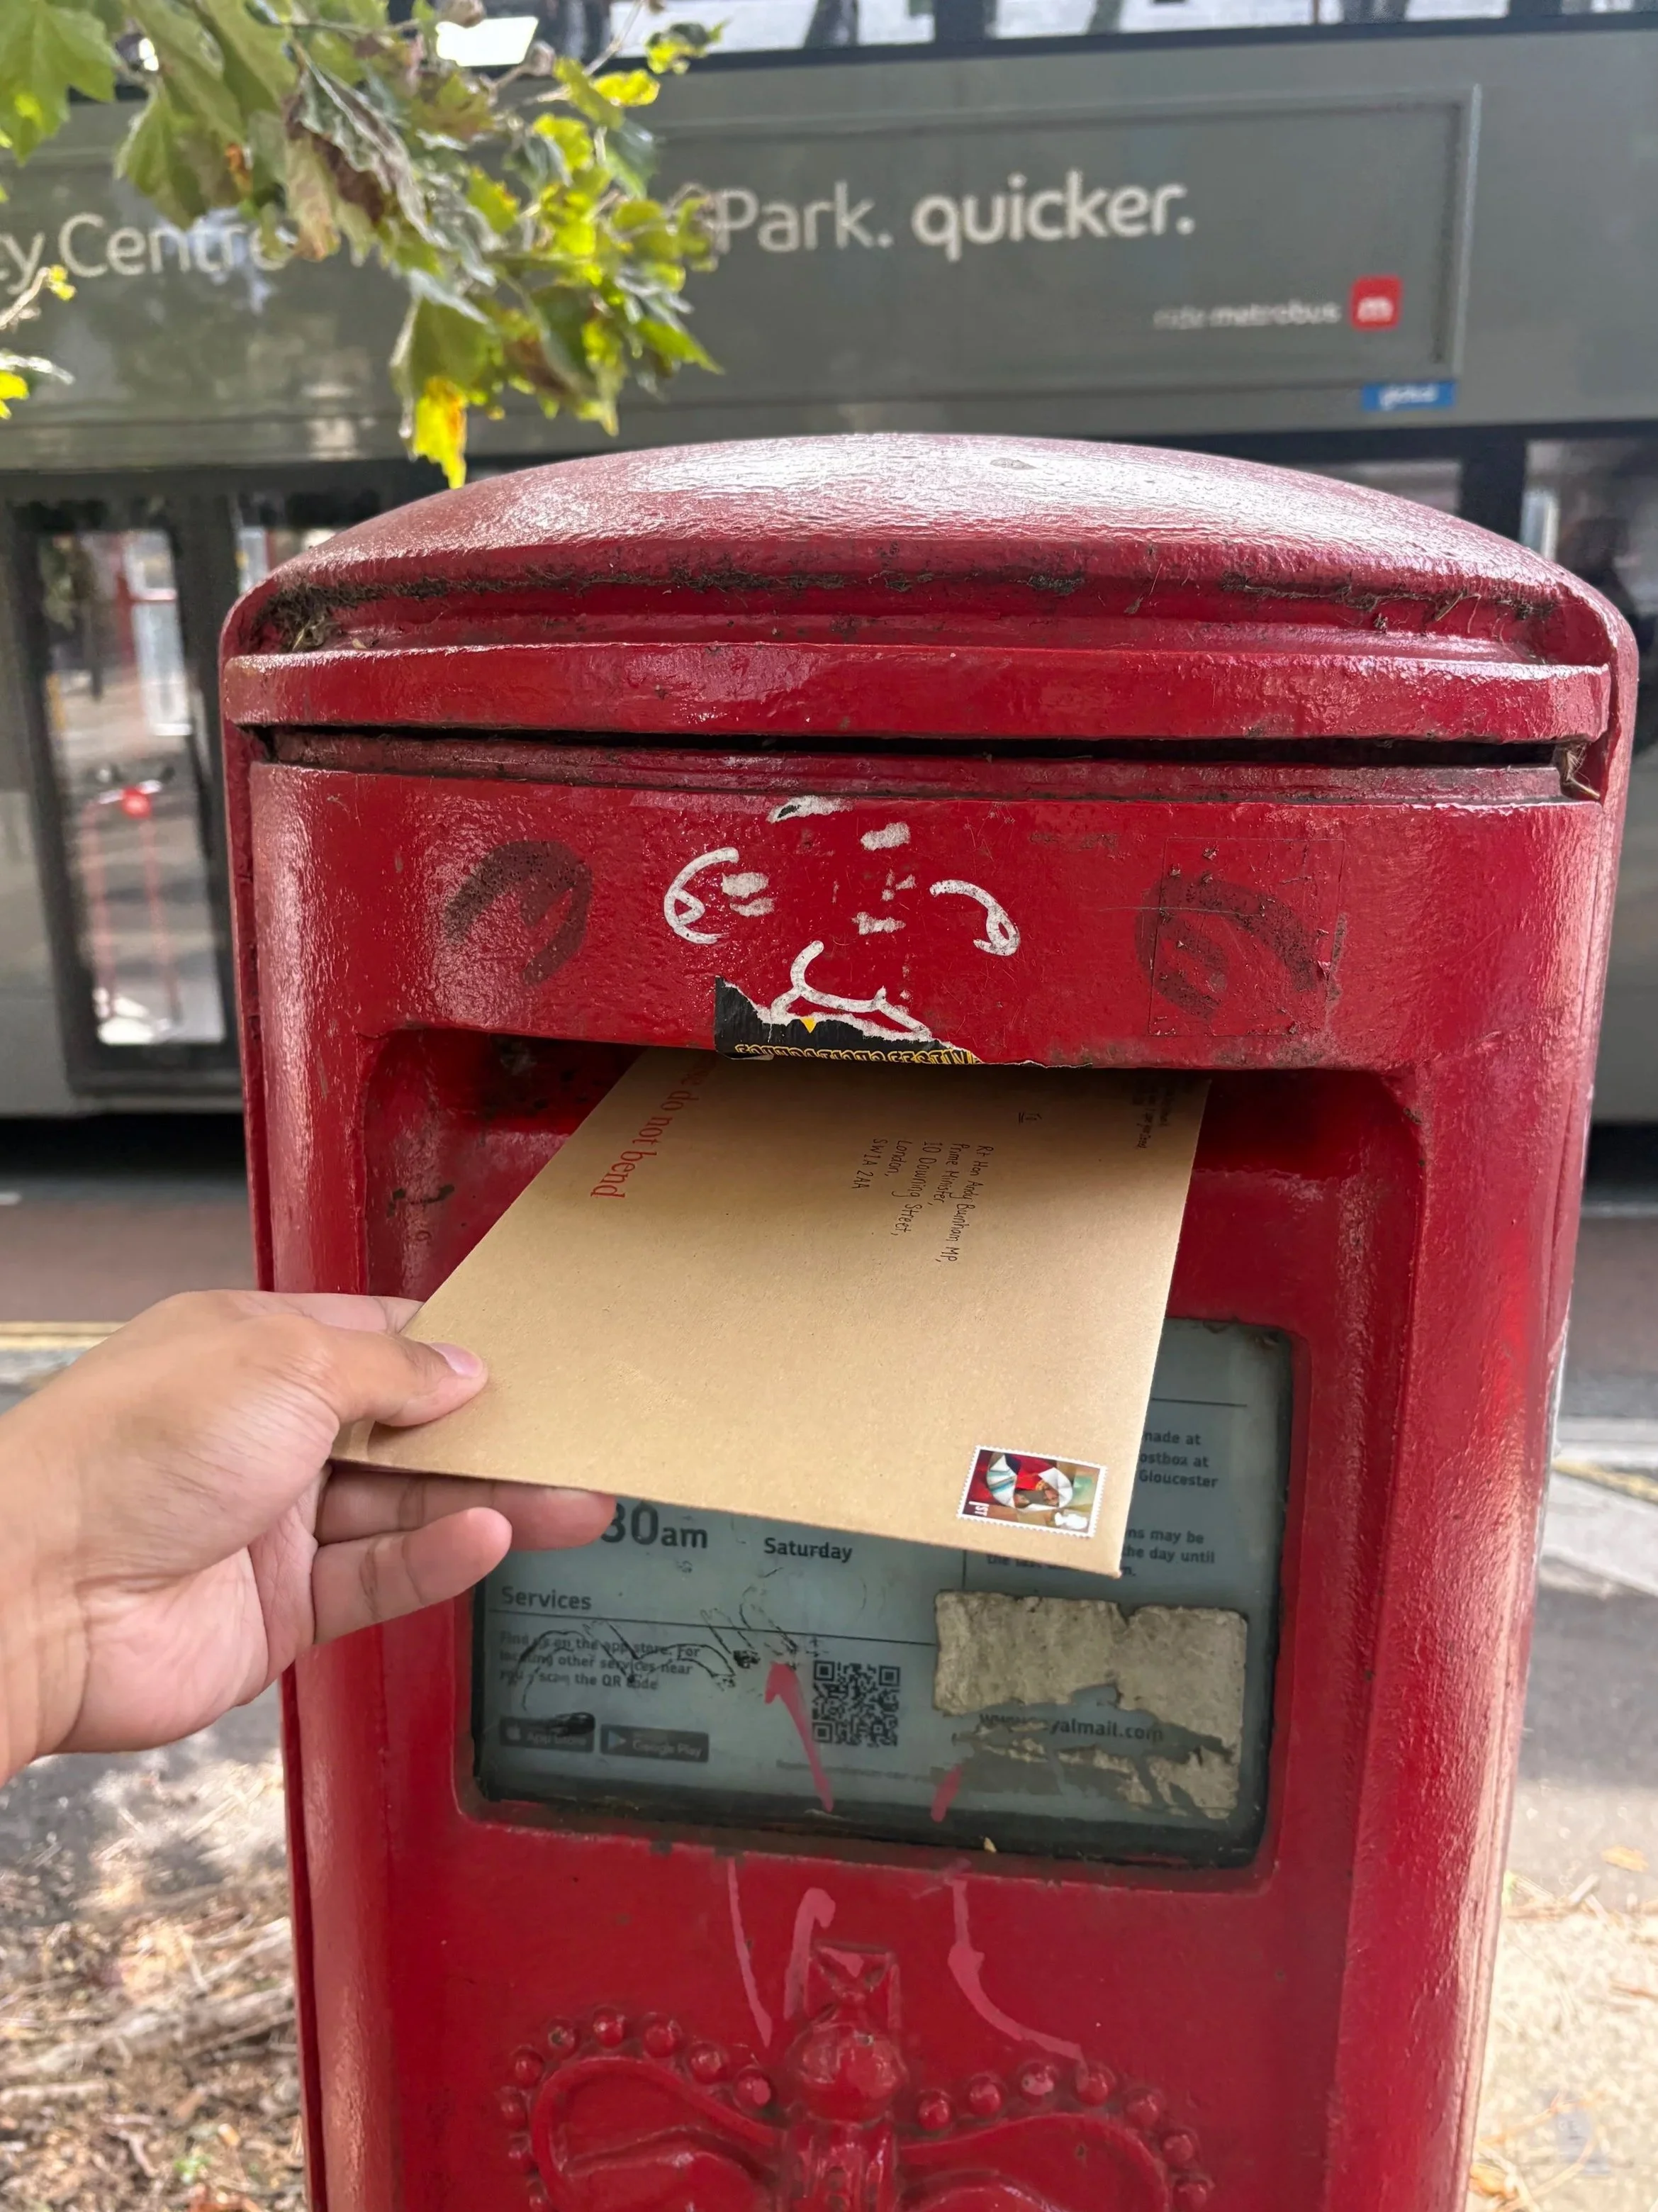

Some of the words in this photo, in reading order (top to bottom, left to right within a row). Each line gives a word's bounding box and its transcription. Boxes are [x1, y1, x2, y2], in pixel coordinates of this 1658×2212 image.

[0, 232, 45, 294] y
[718, 179, 894, 255] Park.
[912, 167, 1196, 262] quicker.
[661, 1090, 699, 1111] do
[632, 1117, 673, 1145] not
[862, 1139, 888, 1166] SW1A
[885, 1140, 912, 1176] London,
[922, 1141, 943, 1154] 10
[946, 1143, 970, 1165] Prime
[976, 1145, 994, 1156] Rt
[590, 1151, 657, 1198] bend
[892, 1157, 936, 1197] Downing
[970, 1161, 989, 1176] Hon
[851, 1170, 874, 1189] 2AA
[928, 1171, 959, 1205] Minister,
[949, 1180, 983, 1202] Andy
[890, 1204, 922, 1236] Street,
[946, 1203, 975, 1241] Burnham
[935, 1246, 960, 1263] MP,
[1185, 1434, 1202, 1446] at
[1140, 1451, 1187, 1466] ostbox
[1193, 1456, 1209, 1468] at
[1138, 1469, 1219, 1488] Gloucester
[1150, 1530, 1182, 1545] may
[1187, 1530, 1204, 1544] be
[763, 1536, 853, 1564] Saturday
[1149, 1546, 1175, 1563] day
[1180, 1551, 1215, 1564] until
[501, 1587, 592, 1611] Services
[576, 1638, 598, 1650] the
[558, 1655, 595, 1668] other
[600, 1659, 656, 1672] services
[661, 1663, 694, 1675] near
[575, 1673, 598, 1685] the
[602, 1674, 622, 1687] QR
